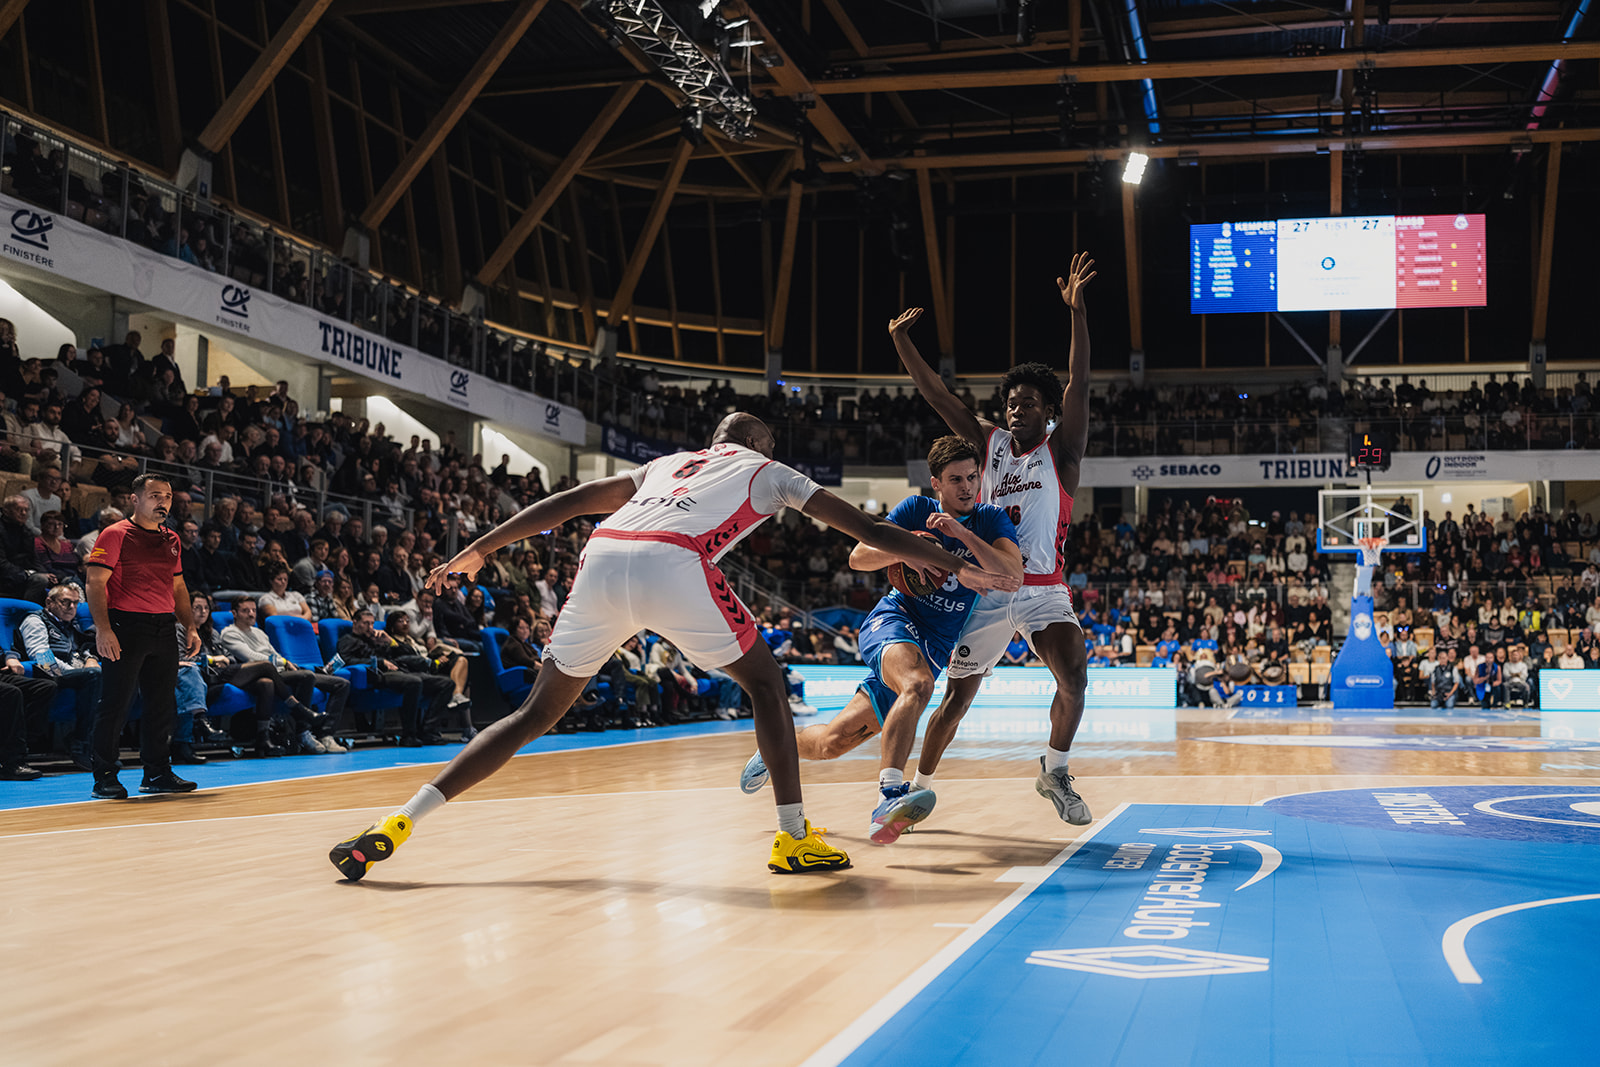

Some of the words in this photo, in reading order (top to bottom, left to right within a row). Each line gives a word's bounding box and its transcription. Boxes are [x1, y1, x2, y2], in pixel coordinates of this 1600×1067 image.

[1293, 222, 1310, 232] 27
[1362, 219, 1379, 230] 27
[319, 321, 402, 379] TRIBUNE
[1358, 448, 1382, 464] 29
[1160, 464, 1221, 476] SEBACO
[1001, 472, 1021, 489] Aix
[1092, 676, 1151, 695] SANTÉ
[1123, 843, 1233, 940] BodemerAuto
